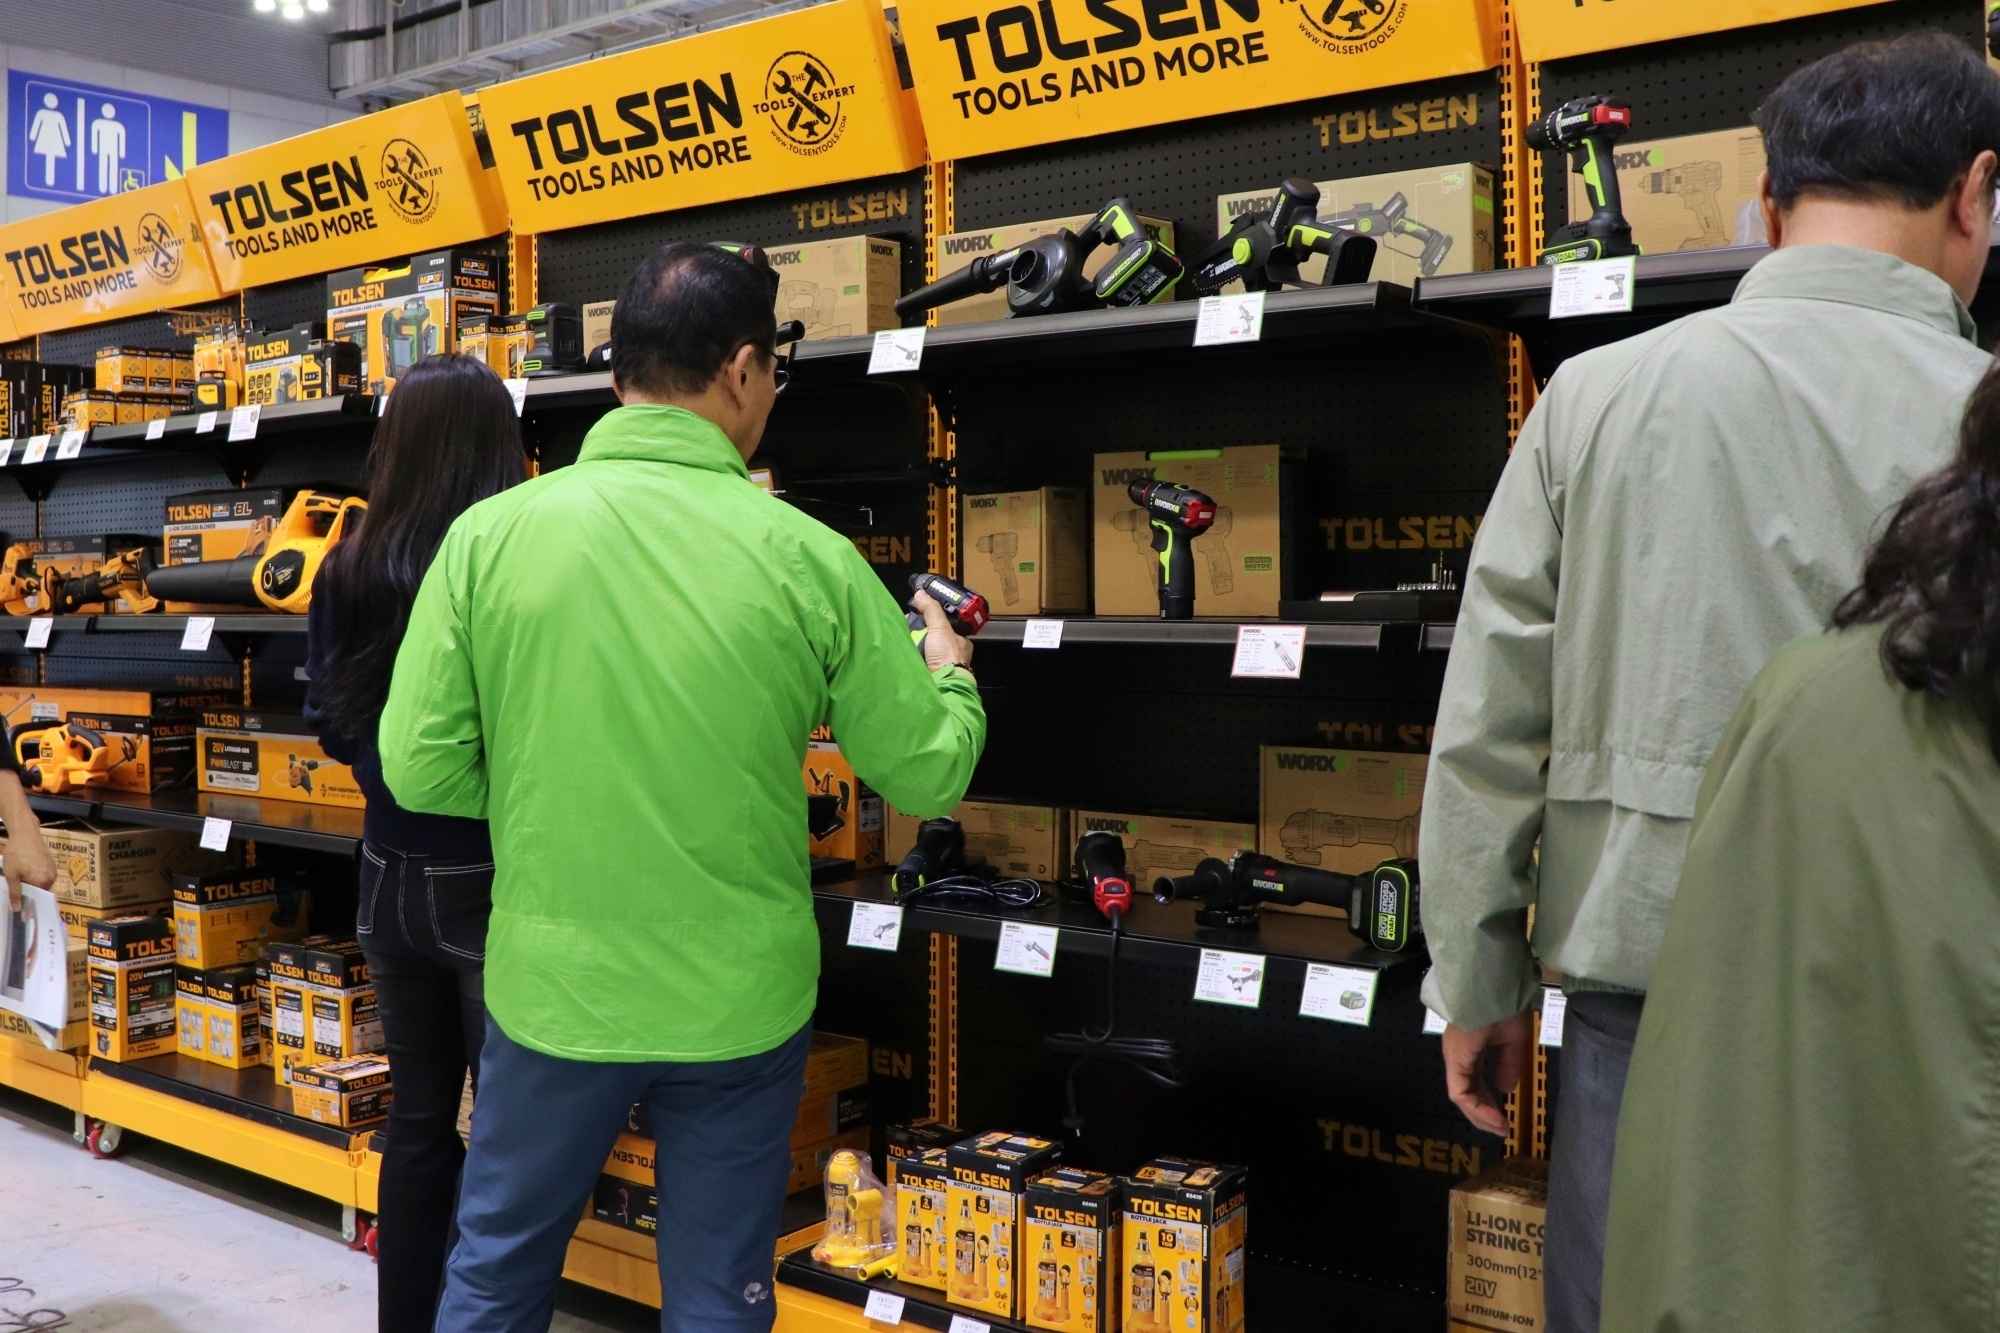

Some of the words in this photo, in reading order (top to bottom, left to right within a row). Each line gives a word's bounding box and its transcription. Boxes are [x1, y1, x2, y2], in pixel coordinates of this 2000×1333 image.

[791, 73, 806, 82] THE
[952, 72, 1062, 119] TOOLS
[1070, 56, 1146, 98] AND
[1154, 30, 1270, 80] MORE
[753, 97, 795, 114] TOOLS
[812, 85, 855, 102] EXPERT
[511, 72, 743, 171] TOLSEN
[1313, 93, 1479, 147] TOLSEN
[1561, 114, 1583, 126] WORX
[771, 115, 847, 156] WWW.TOLSENTOOLS.COM
[527, 165, 605, 201] TOOLS
[611, 153, 664, 186] AND
[668, 135, 752, 175] MORE
[374, 176, 403, 190] TOOLS
[414, 167, 443, 179] EXPERT
[210, 155, 369, 234] TOLSEN
[792, 188, 908, 229] TOLSEN
[225, 231, 279, 260] TOOLS
[283, 222, 319, 248] AND
[321, 208, 378, 238] MORE
[134, 245, 156, 255] TOOLS
[163, 238, 186, 249] EXPERT
[870, 244, 893, 256] WORX
[945, 234, 993, 255] WORX
[5, 226, 130, 287] TOLSEN
[19, 284, 62, 309] TOOLS
[64, 280, 97, 302] AND
[94, 270, 138, 295] MORE
[454, 275, 495, 290] TOLSEN
[332, 282, 385, 306] TOLSEN
[457, 304, 469, 312] 20V
[463, 325, 486, 335] TOLSEN
[506, 323, 526, 333] TOLSEN
[248, 339, 289, 361] TOLSEN
[234, 502, 252, 516] BL
[971, 498, 998, 508] WORX
[1157, 499, 1176, 512] WORX
[168, 504, 211, 521] TOLSEN
[933, 580, 955, 599] WORX
[72, 717, 99, 729] TOLSEN
[203, 713, 239, 727] TOLSEN
[152, 725, 195, 736] TOLSEN
[212, 742, 225, 753] 20V
[225, 745, 250, 754] LITHIUM-ION
[1277, 753, 1336, 772] WORX
[1085, 817, 1130, 834] WORX
[49, 841, 60, 850] FAST
[62, 843, 87, 854] CHARGER
[109, 839, 132, 850] FAST
[109, 847, 156, 860] CHARGER
[204, 878, 275, 901] TOLSEN
[1256, 879, 1279, 891] WORX
[174, 889, 196, 902] TOLSEN
[1382, 883, 1390, 913] KROSS
[1379, 914, 1388, 938] 20V
[89, 944, 117, 959] TOLSEN
[126, 937, 176, 958] TOLS
[129, 972, 143, 981] 20V
[144, 968, 173, 978] LITHIUM-ION
[271, 962, 304, 979] TOLSEN
[307, 970, 342, 988] TOLSEN
[177, 980, 203, 994] TOLSEN
[207, 986, 233, 1002] TOLSEN
[362, 996, 376, 1005] 20V
[293, 1071, 320, 1085] TOLSEN
[348, 1074, 386, 1090] TOLSEN
[1316, 1118, 1481, 1176] TOLSEN
[902, 1174, 947, 1192] TOLSEN
[953, 1167, 1011, 1190] TOLSEN
[954, 1181, 971, 1189] BOTTLE
[971, 1184, 983, 1192] JACK
[979, 1199, 986, 1207] 6
[1130, 1198, 1201, 1222] TOLSEN
[1214, 1191, 1245, 1221] TOLSEN
[1034, 1205, 1097, 1227] TOLSEN
[1131, 1214, 1152, 1223] BOTTLE
[1152, 1217, 1167, 1225] JACK
[1467, 1210, 1522, 1234] LI-ION
[1065, 1234, 1072, 1242] 4
[1161, 1233, 1174, 1242] 10
[1467, 1228, 1531, 1253] STRING
[1465, 1275, 1497, 1299] 20V
[1465, 1303, 1535, 1327] LITHIUM-ION
